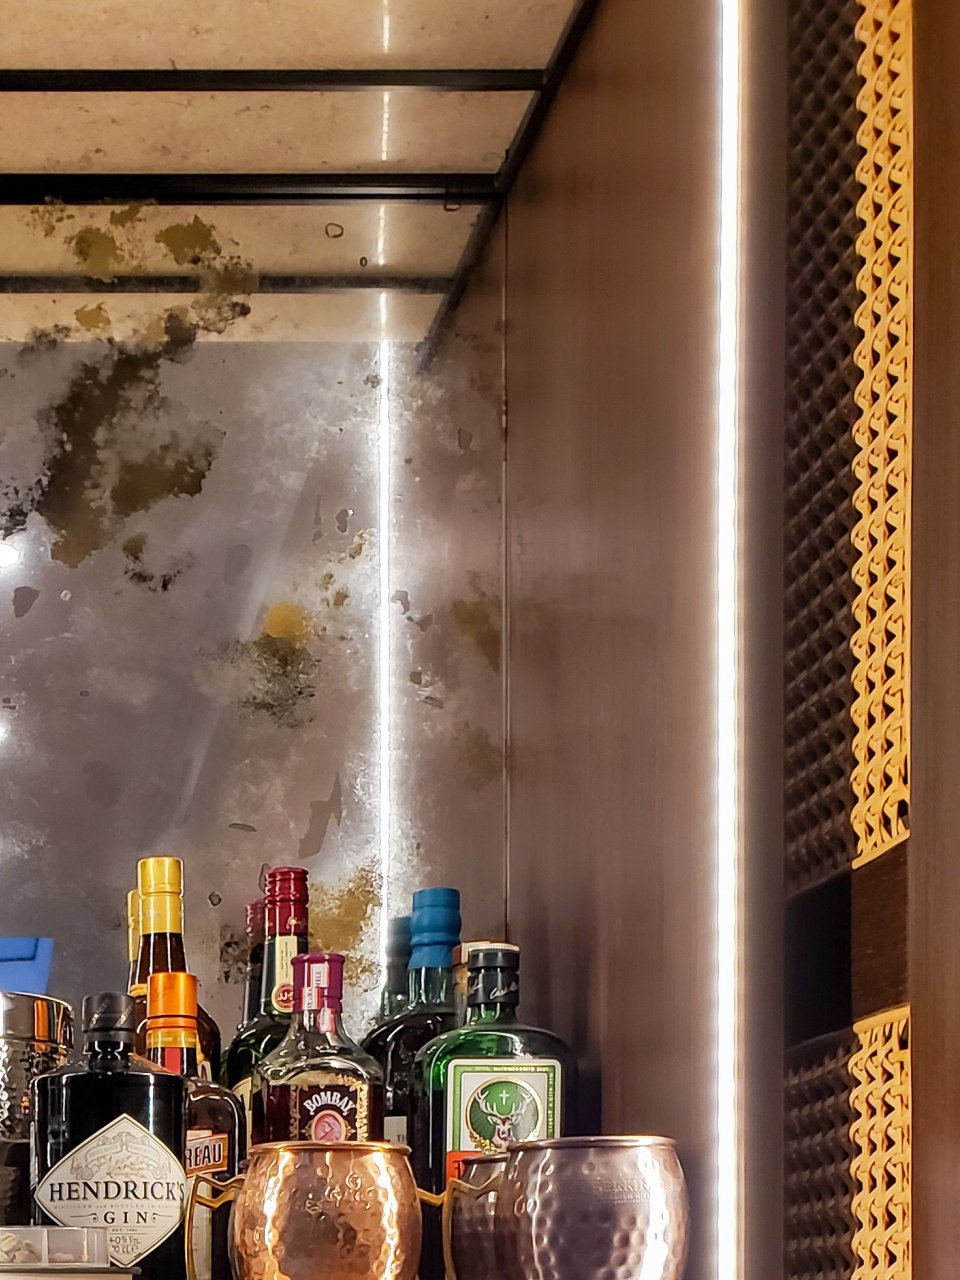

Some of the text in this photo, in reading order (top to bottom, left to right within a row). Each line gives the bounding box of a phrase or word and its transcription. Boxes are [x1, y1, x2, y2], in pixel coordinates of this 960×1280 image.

[303, 1090, 356, 1116] BOMBAY
[49, 1180, 185, 1202] HENDRICK'S
[103, 1211, 148, 1225] GIN
